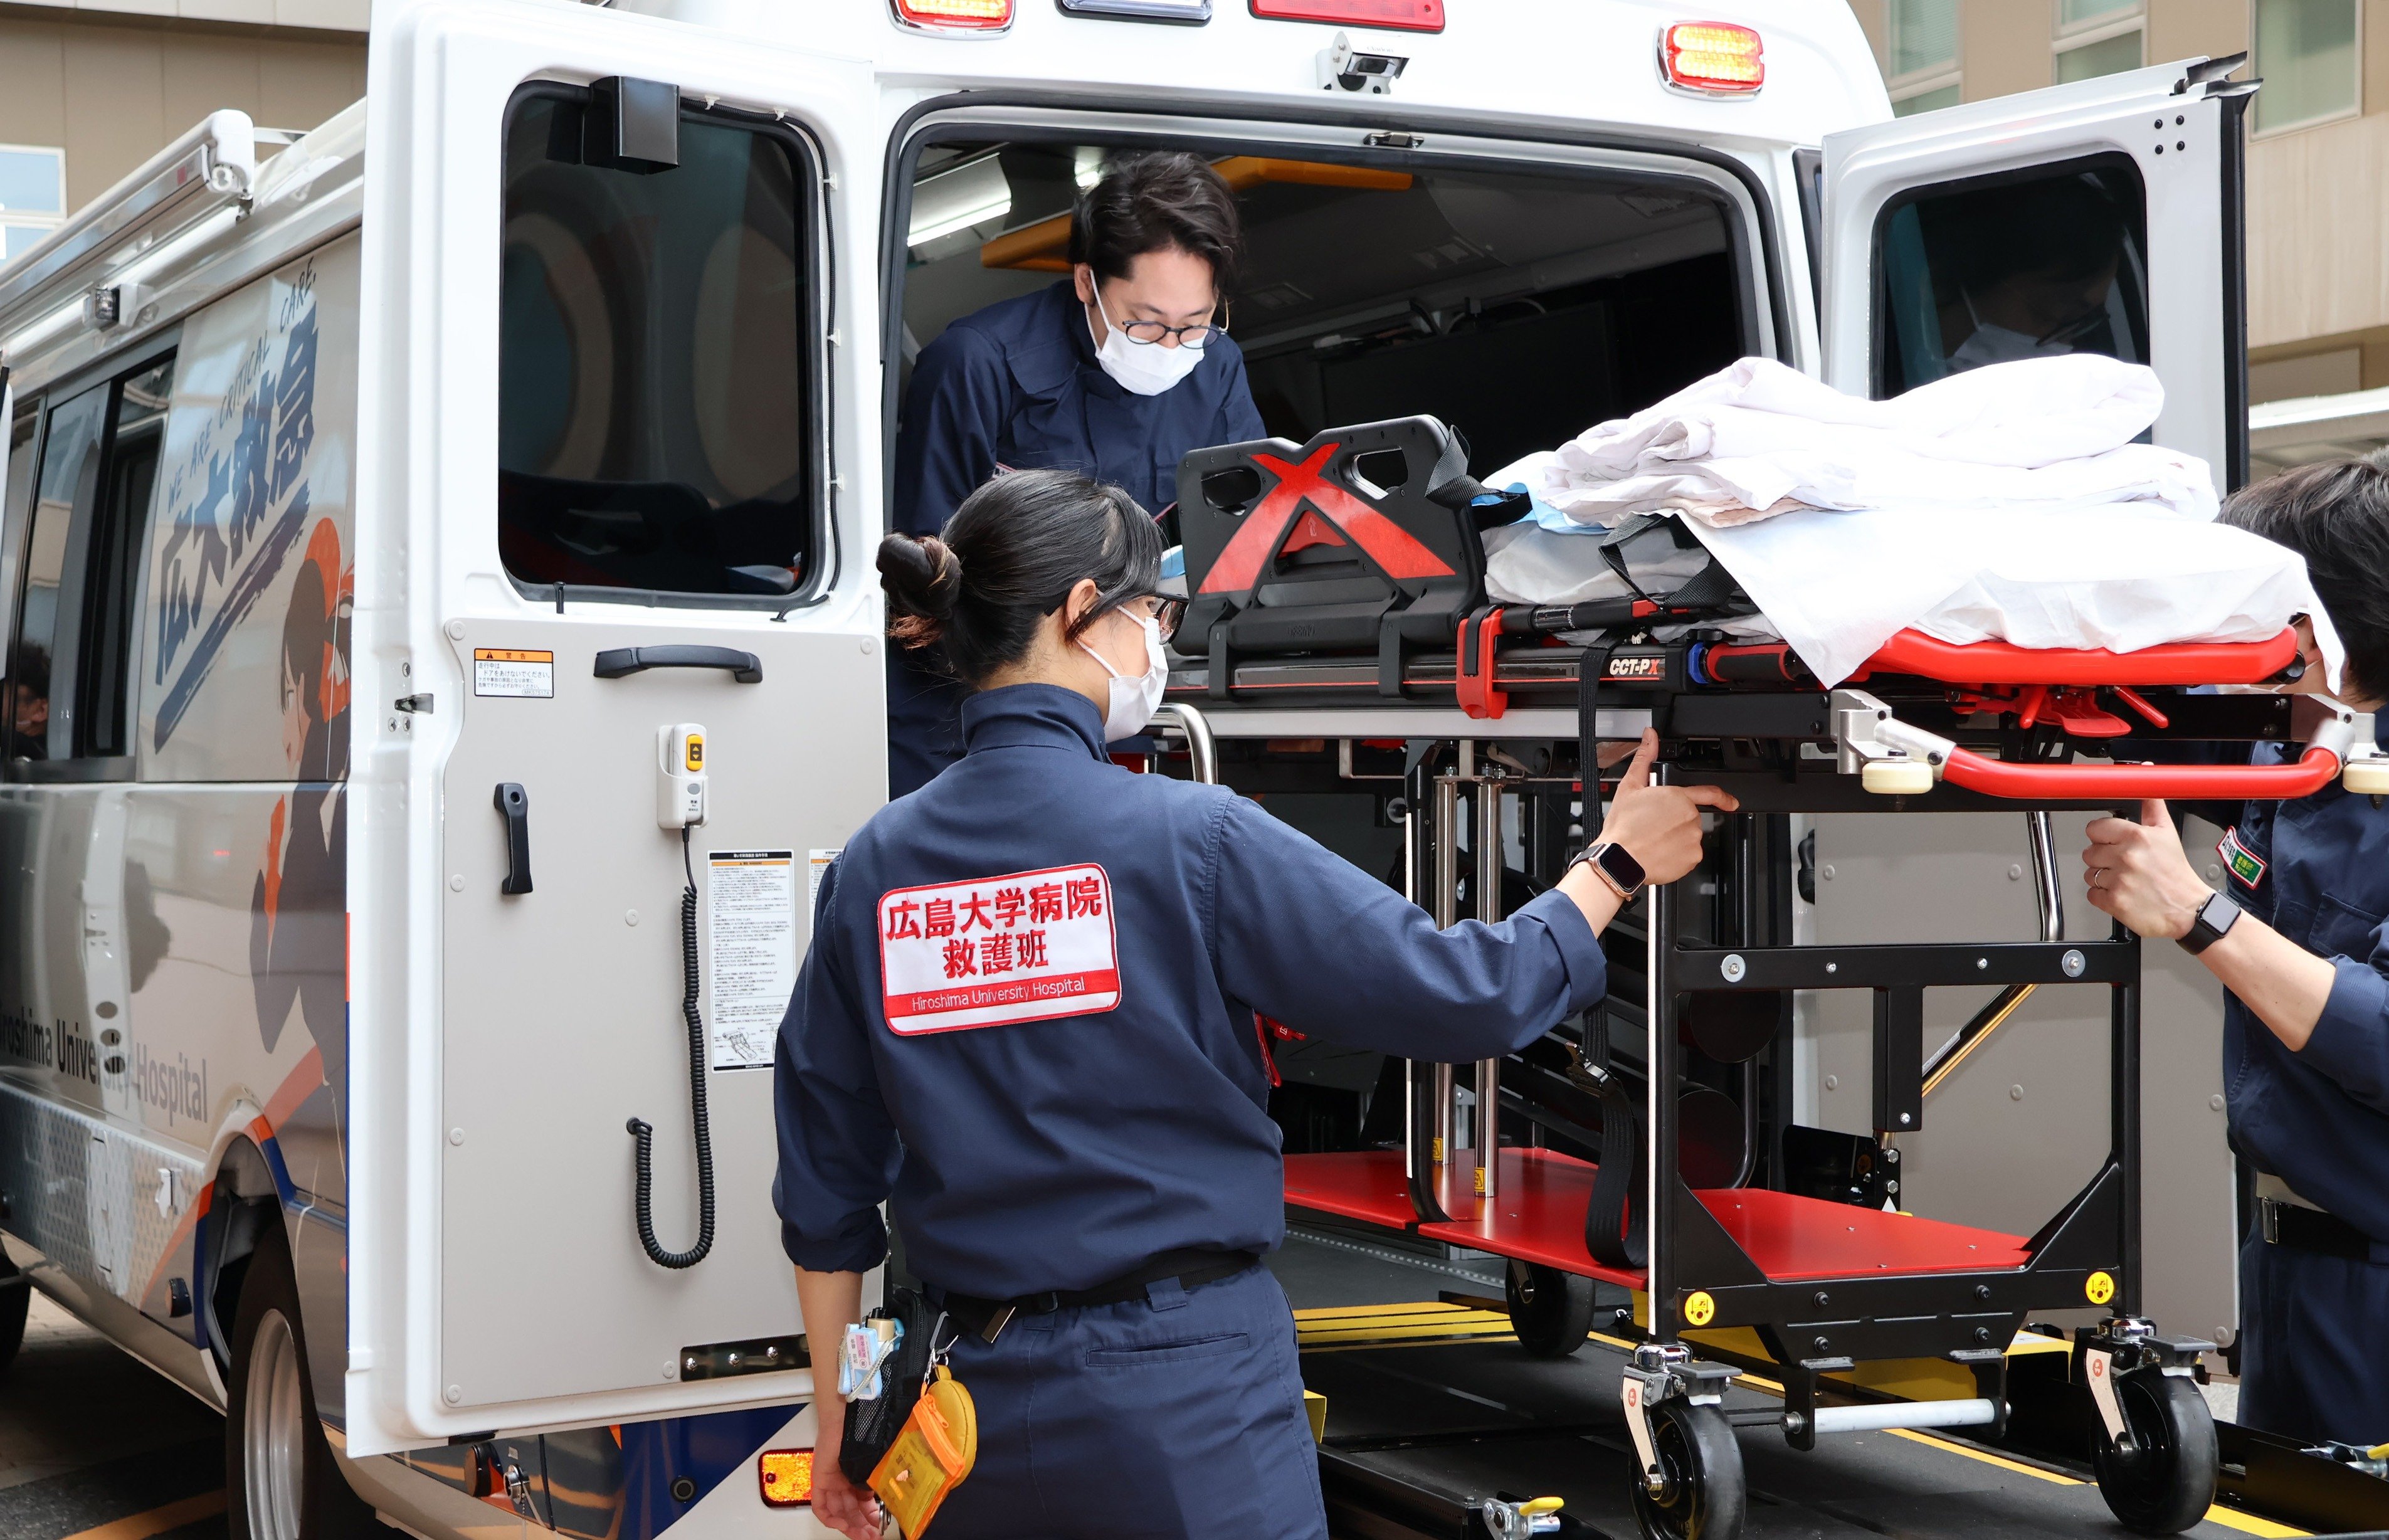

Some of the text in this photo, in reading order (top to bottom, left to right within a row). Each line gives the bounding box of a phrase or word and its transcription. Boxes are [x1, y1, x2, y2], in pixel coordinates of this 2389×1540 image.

[190, 418, 212, 478] ARE
[220, 330, 270, 429] CRITICAL
[1610, 658, 1660, 675] CCT-PX
[885, 876, 1103, 941] 広島大学病院
[942, 929, 1049, 979] 救護班
[912, 976, 1085, 1012] Hiroshima University Hospital
[136, 1042, 208, 1127] Hospital
